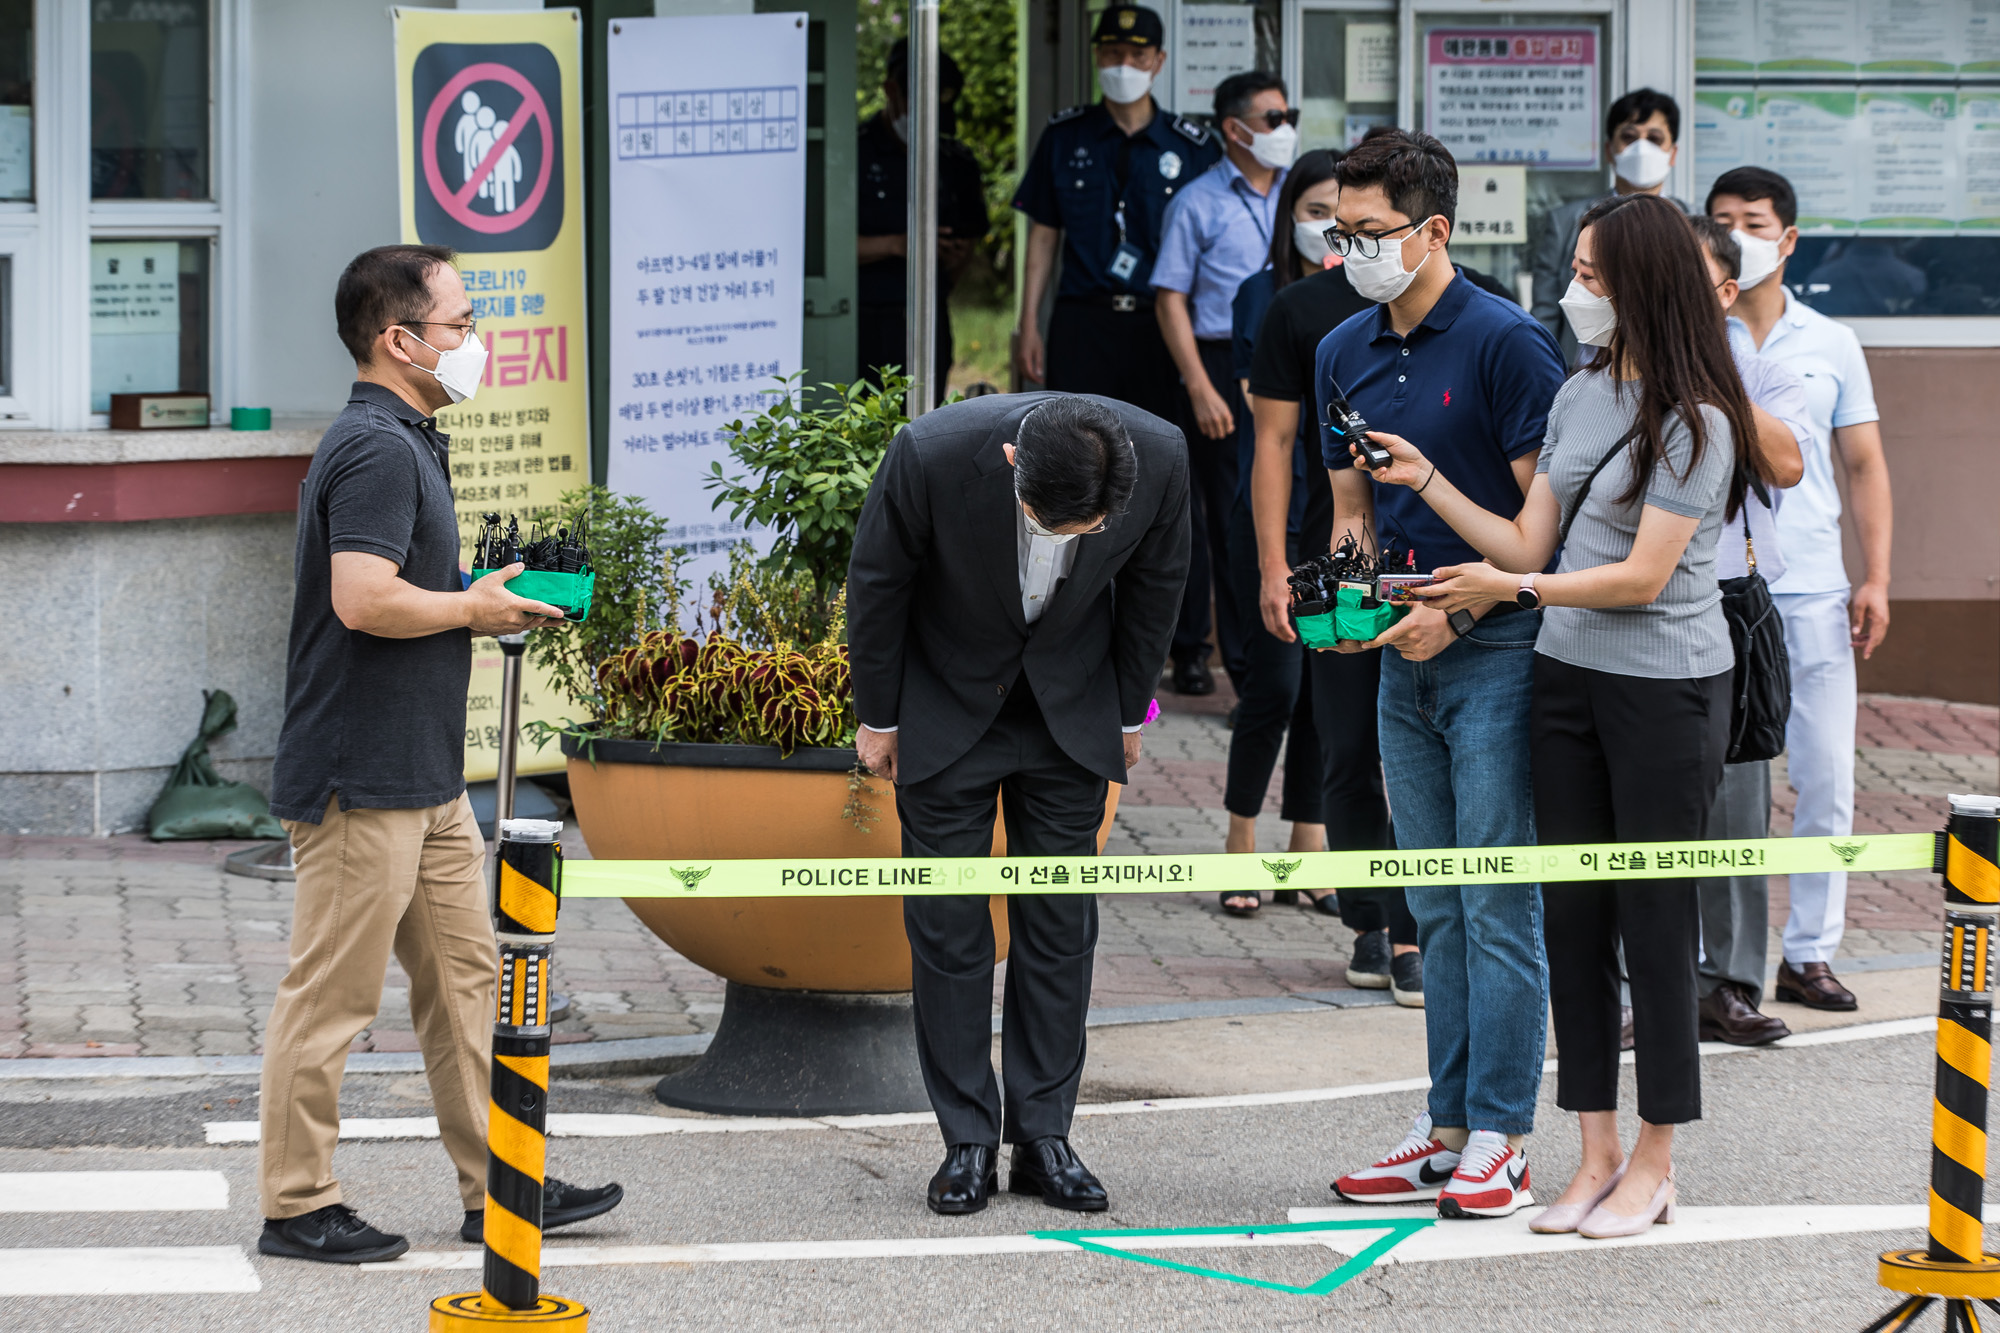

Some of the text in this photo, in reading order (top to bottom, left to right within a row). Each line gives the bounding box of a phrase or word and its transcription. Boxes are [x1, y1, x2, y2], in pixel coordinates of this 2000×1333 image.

[731, 96, 762, 118] 일상
[637, 247, 779, 275] 아프면 3-4일 집에 머물기
[461, 269, 527, 293] 코로나19
[637, 278, 775, 307] 두 팔 간격 건강 거리 두기
[471, 293, 546, 319] 방지를 위한
[632, 370, 660, 389] 30초
[706, 363, 740, 384] 기침은
[744, 359, 780, 380] 옷소매
[437, 407, 550, 430] 로나19 확산 방지와
[618, 400, 644, 422] 매일
[646, 401, 659, 420] 두
[676, 397, 700, 417] 이상
[479, 434, 515, 454] 안전을
[520, 431, 543, 450] 위해
[623, 434, 660, 454] 거리는
[451, 461, 476, 479] 예방
[480, 460, 490, 478] 및
[493, 458, 521, 478] 관리에
[523, 456, 545, 475] 관한
[505, 481, 529, 499] 의거
[1370, 858, 1454, 877] POLICE
[1463, 856, 1514, 875] LINE
[1579, 848, 1765, 871] 이 선을 넘지마시오!
[781, 868, 869, 886] POLICE
[878, 867, 932, 886] LINE
[1000, 863, 1194, 885] 이 선을 넘지마시오!
